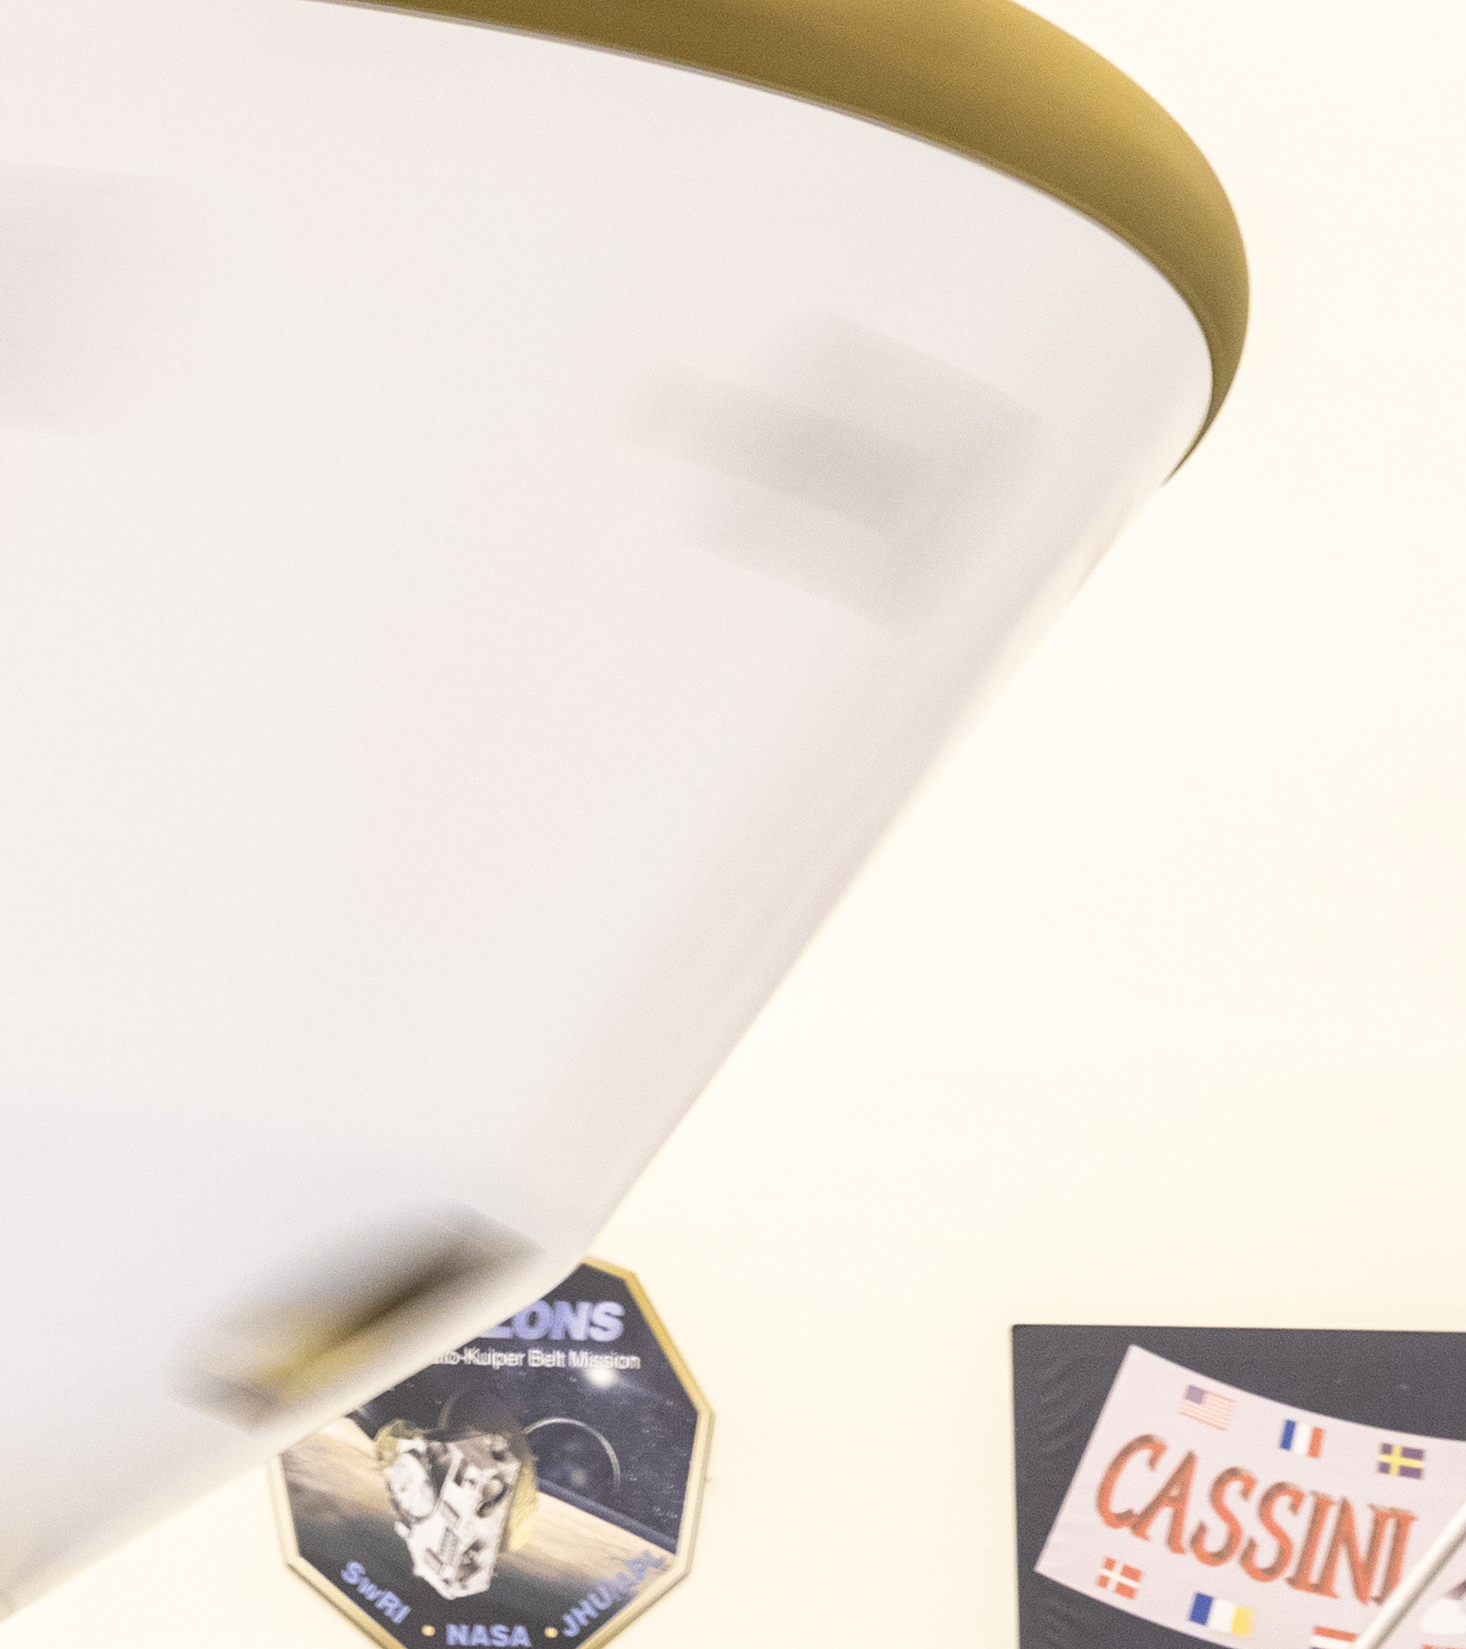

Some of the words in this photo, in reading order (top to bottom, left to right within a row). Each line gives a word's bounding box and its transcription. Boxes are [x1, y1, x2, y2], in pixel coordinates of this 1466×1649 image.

[527, 1349, 567, 1369] Belt
[568, 1351, 642, 1370] Mission
[1094, 1433, 1421, 1607] CASSINI
[341, 1561, 412, 1624] SwRI
[445, 1624, 532, 1648] NASA
